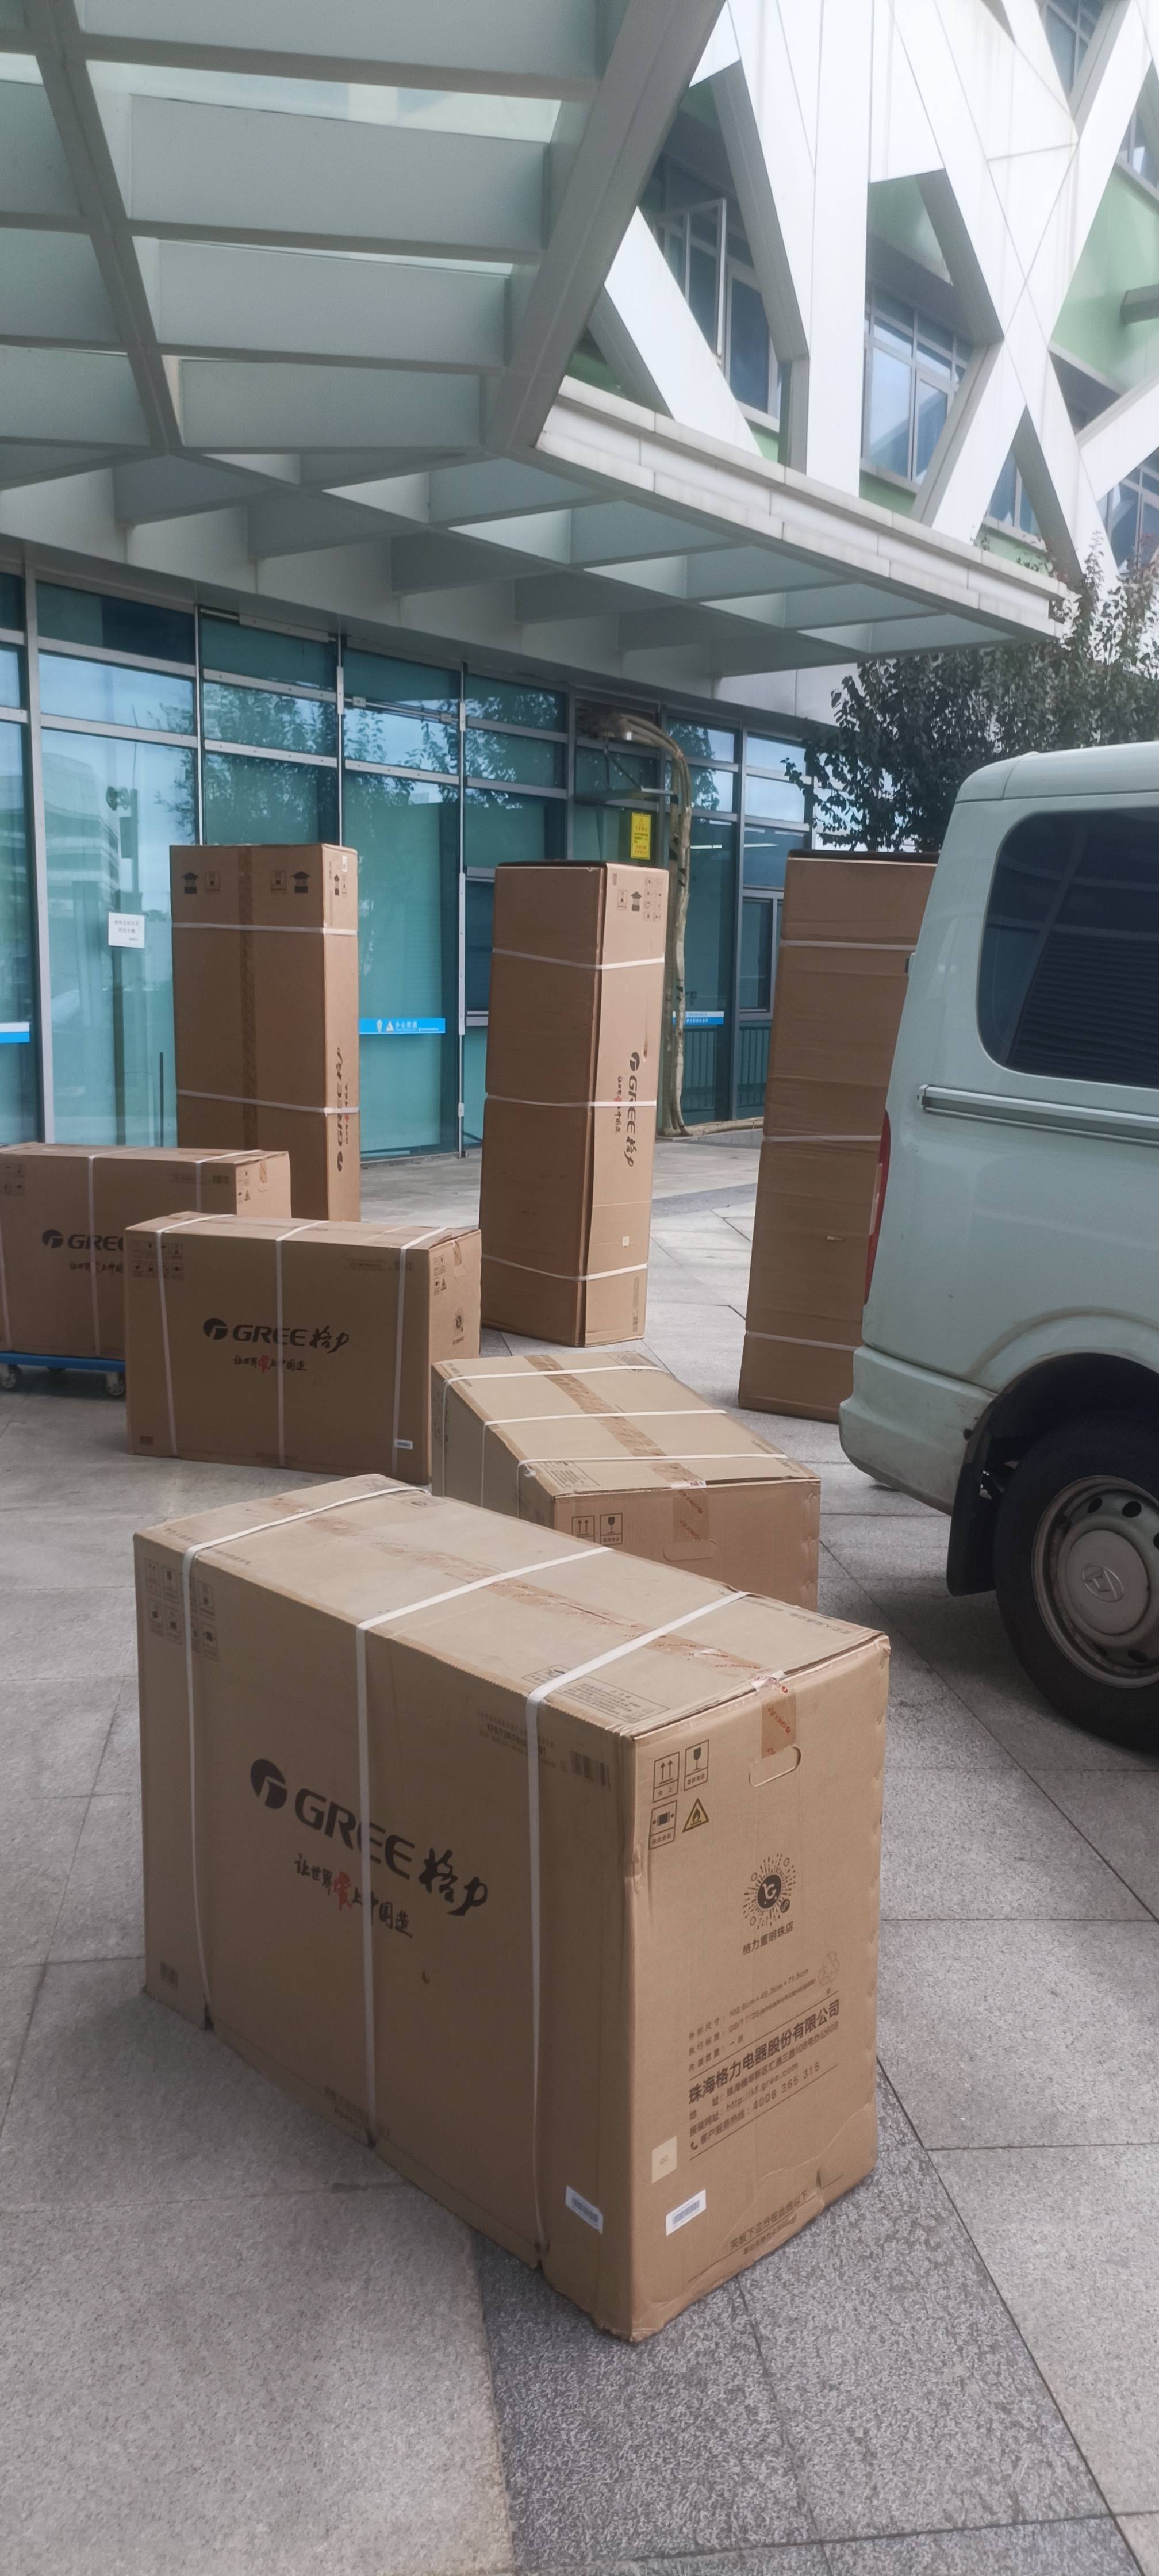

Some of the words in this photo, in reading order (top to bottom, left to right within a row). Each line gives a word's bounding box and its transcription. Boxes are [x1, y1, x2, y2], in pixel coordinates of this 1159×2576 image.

[232, 1324, 308, 1347] GREE
[294, 1788, 416, 1880] GREE
[419, 1847, 488, 1916] 格力
[743, 1920, 794, 1955] 格力董明珠店
[689, 1998, 839, 2106] 珠海格力电器股份有限公司
[803, 2061, 819, 2078] 315
